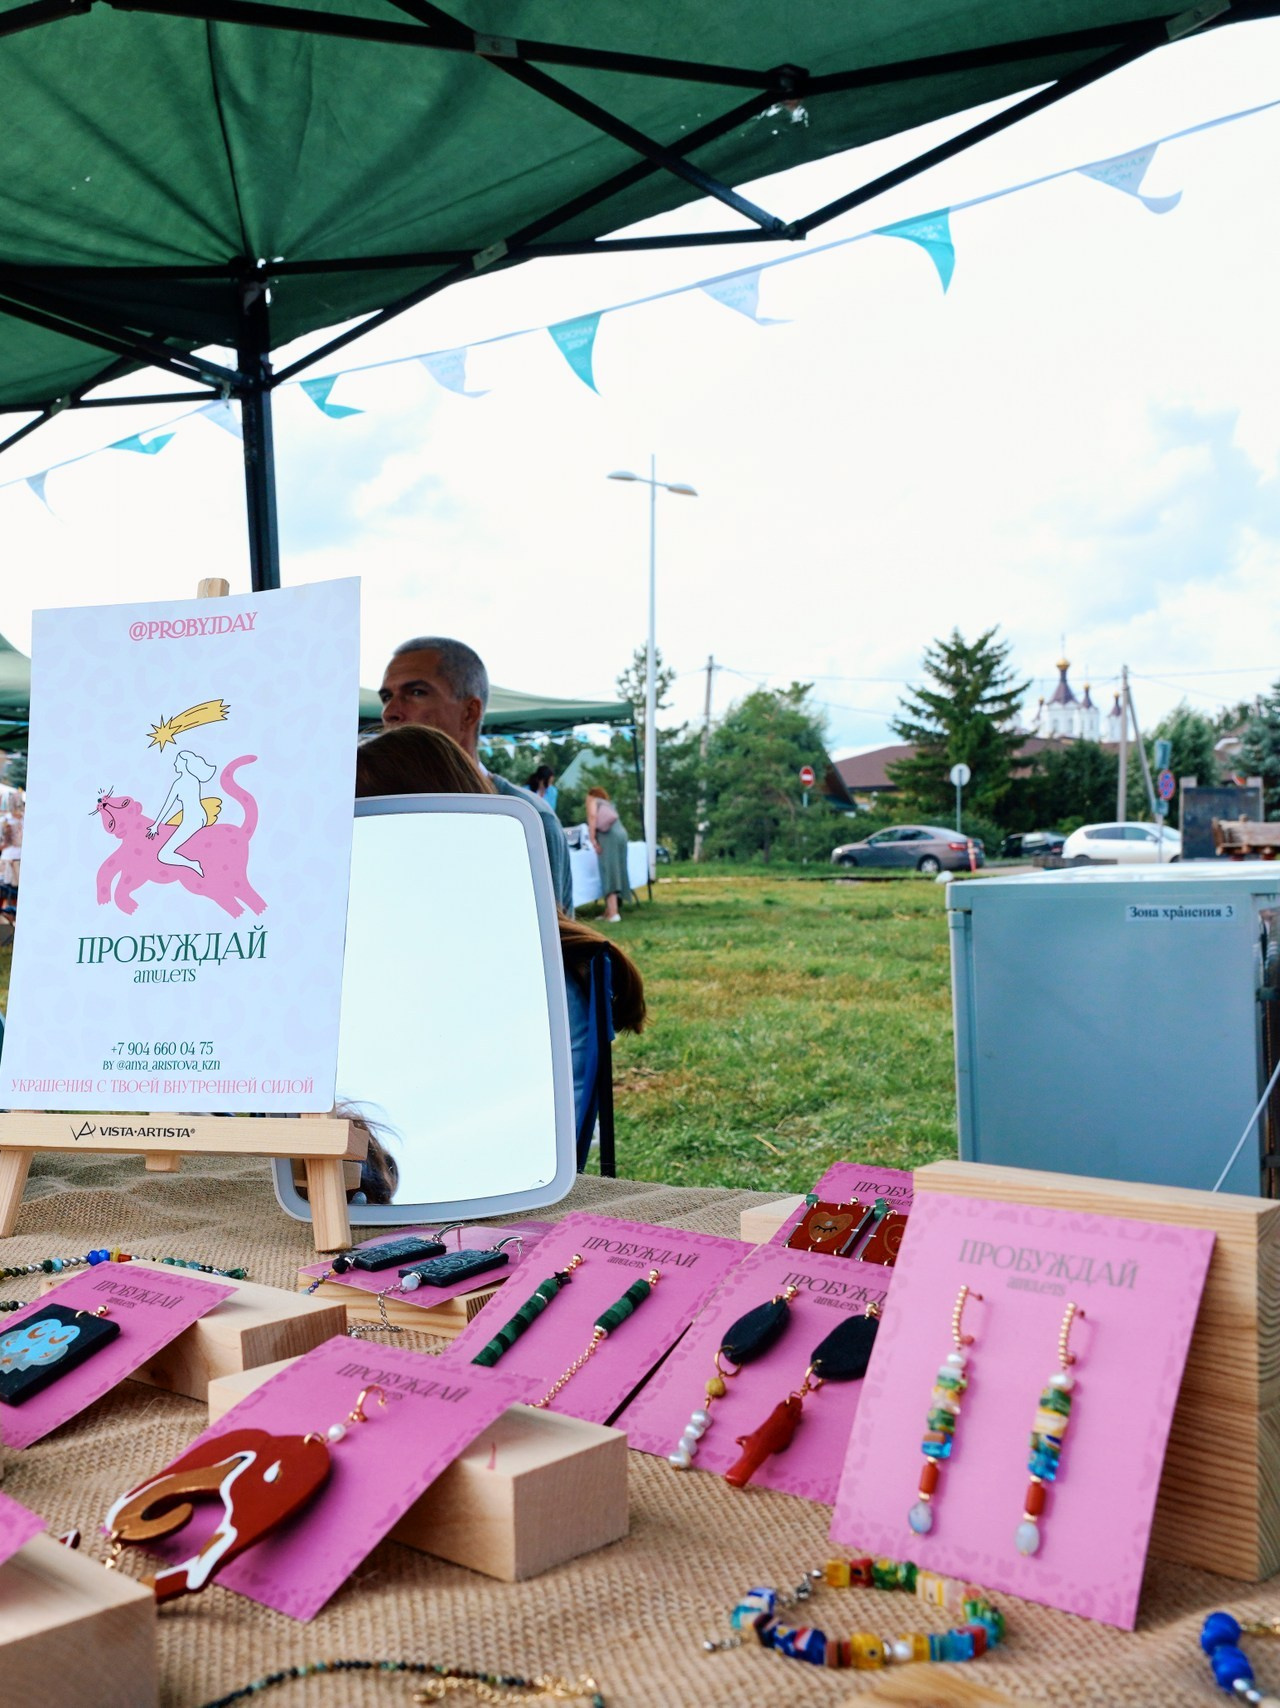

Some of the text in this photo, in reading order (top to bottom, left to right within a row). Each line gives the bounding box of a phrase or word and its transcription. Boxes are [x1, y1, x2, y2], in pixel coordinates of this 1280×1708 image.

[129, 611, 258, 642] @PROBYJDAY
[1129, 905, 1234, 921] Зона хранения 3
[76, 924, 269, 967] ПРОБУЖДАЙ
[111, 1041, 214, 1056] +7 904 660 04 75
[11, 1078, 93, 1093] УКРАШЕНИЯ
[110, 1077, 159, 1093] ТВОЕЙ
[164, 1077, 257, 1094] ВНУТРЕННЕЙ
[261, 1076, 314, 1094] СИЛОЙ
[852, 1181, 915, 1198] ПРОБУ
[582, 1236, 700, 1268] ПРОБУЖДАЙ
[958, 1239, 1140, 1290] ПРОБУЖДАЙ
[92, 1280, 184, 1309] ПРОБУЖДАЙ
[336, 1363, 471, 1403] ПРОБУЖДАЙ
